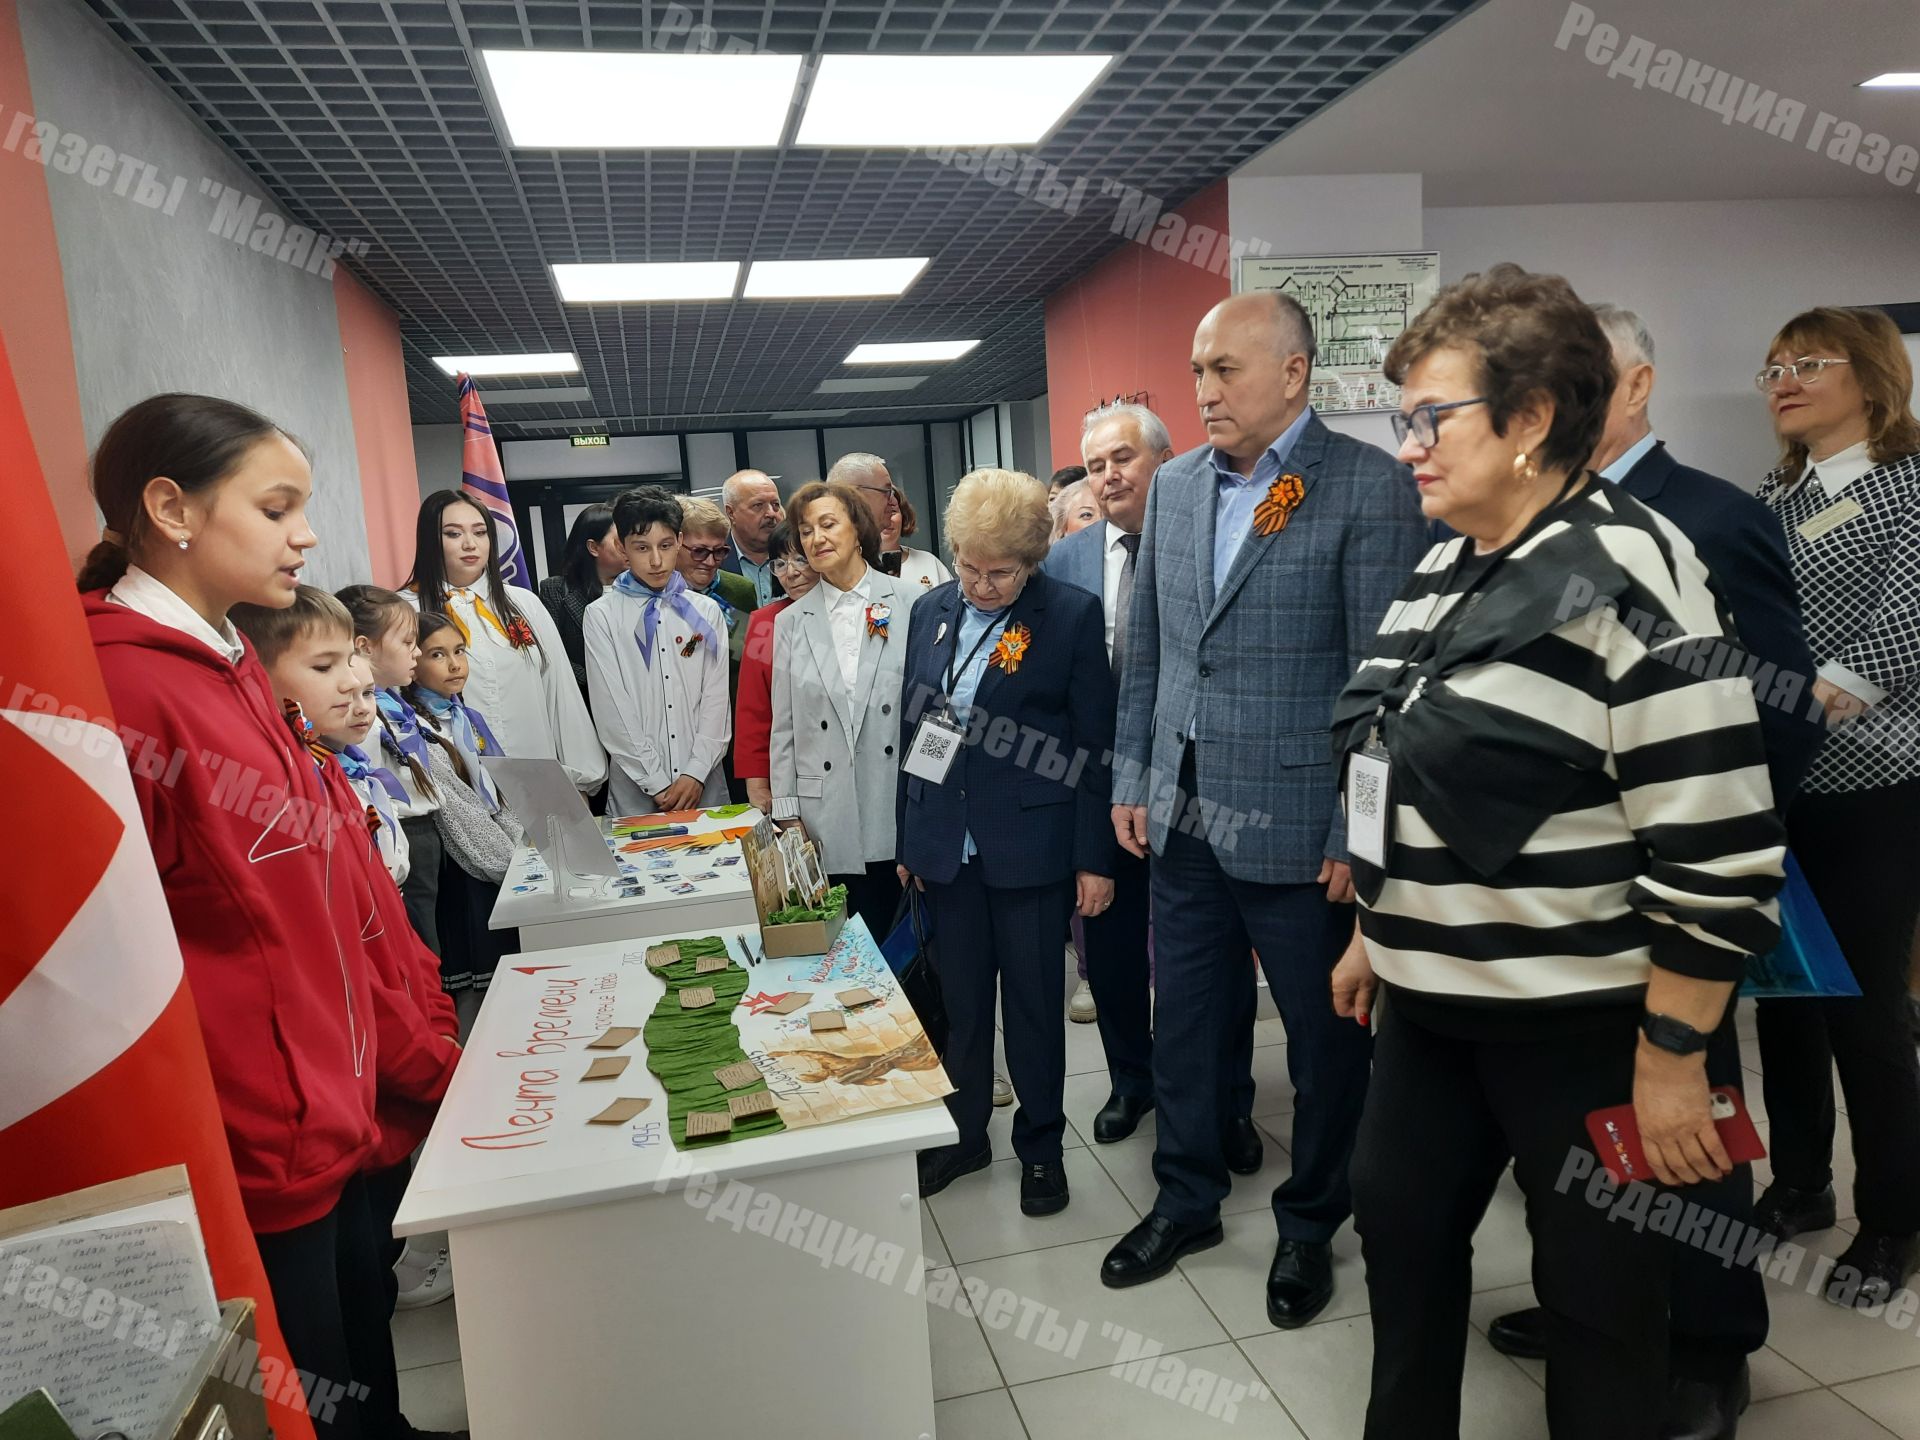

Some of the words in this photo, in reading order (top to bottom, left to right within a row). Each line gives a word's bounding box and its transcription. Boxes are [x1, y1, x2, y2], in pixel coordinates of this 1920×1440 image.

[573, 436, 607, 446] ВЫХОД
[460, 1068, 560, 1151] Лента
[631, 1121, 661, 1149] 1945
